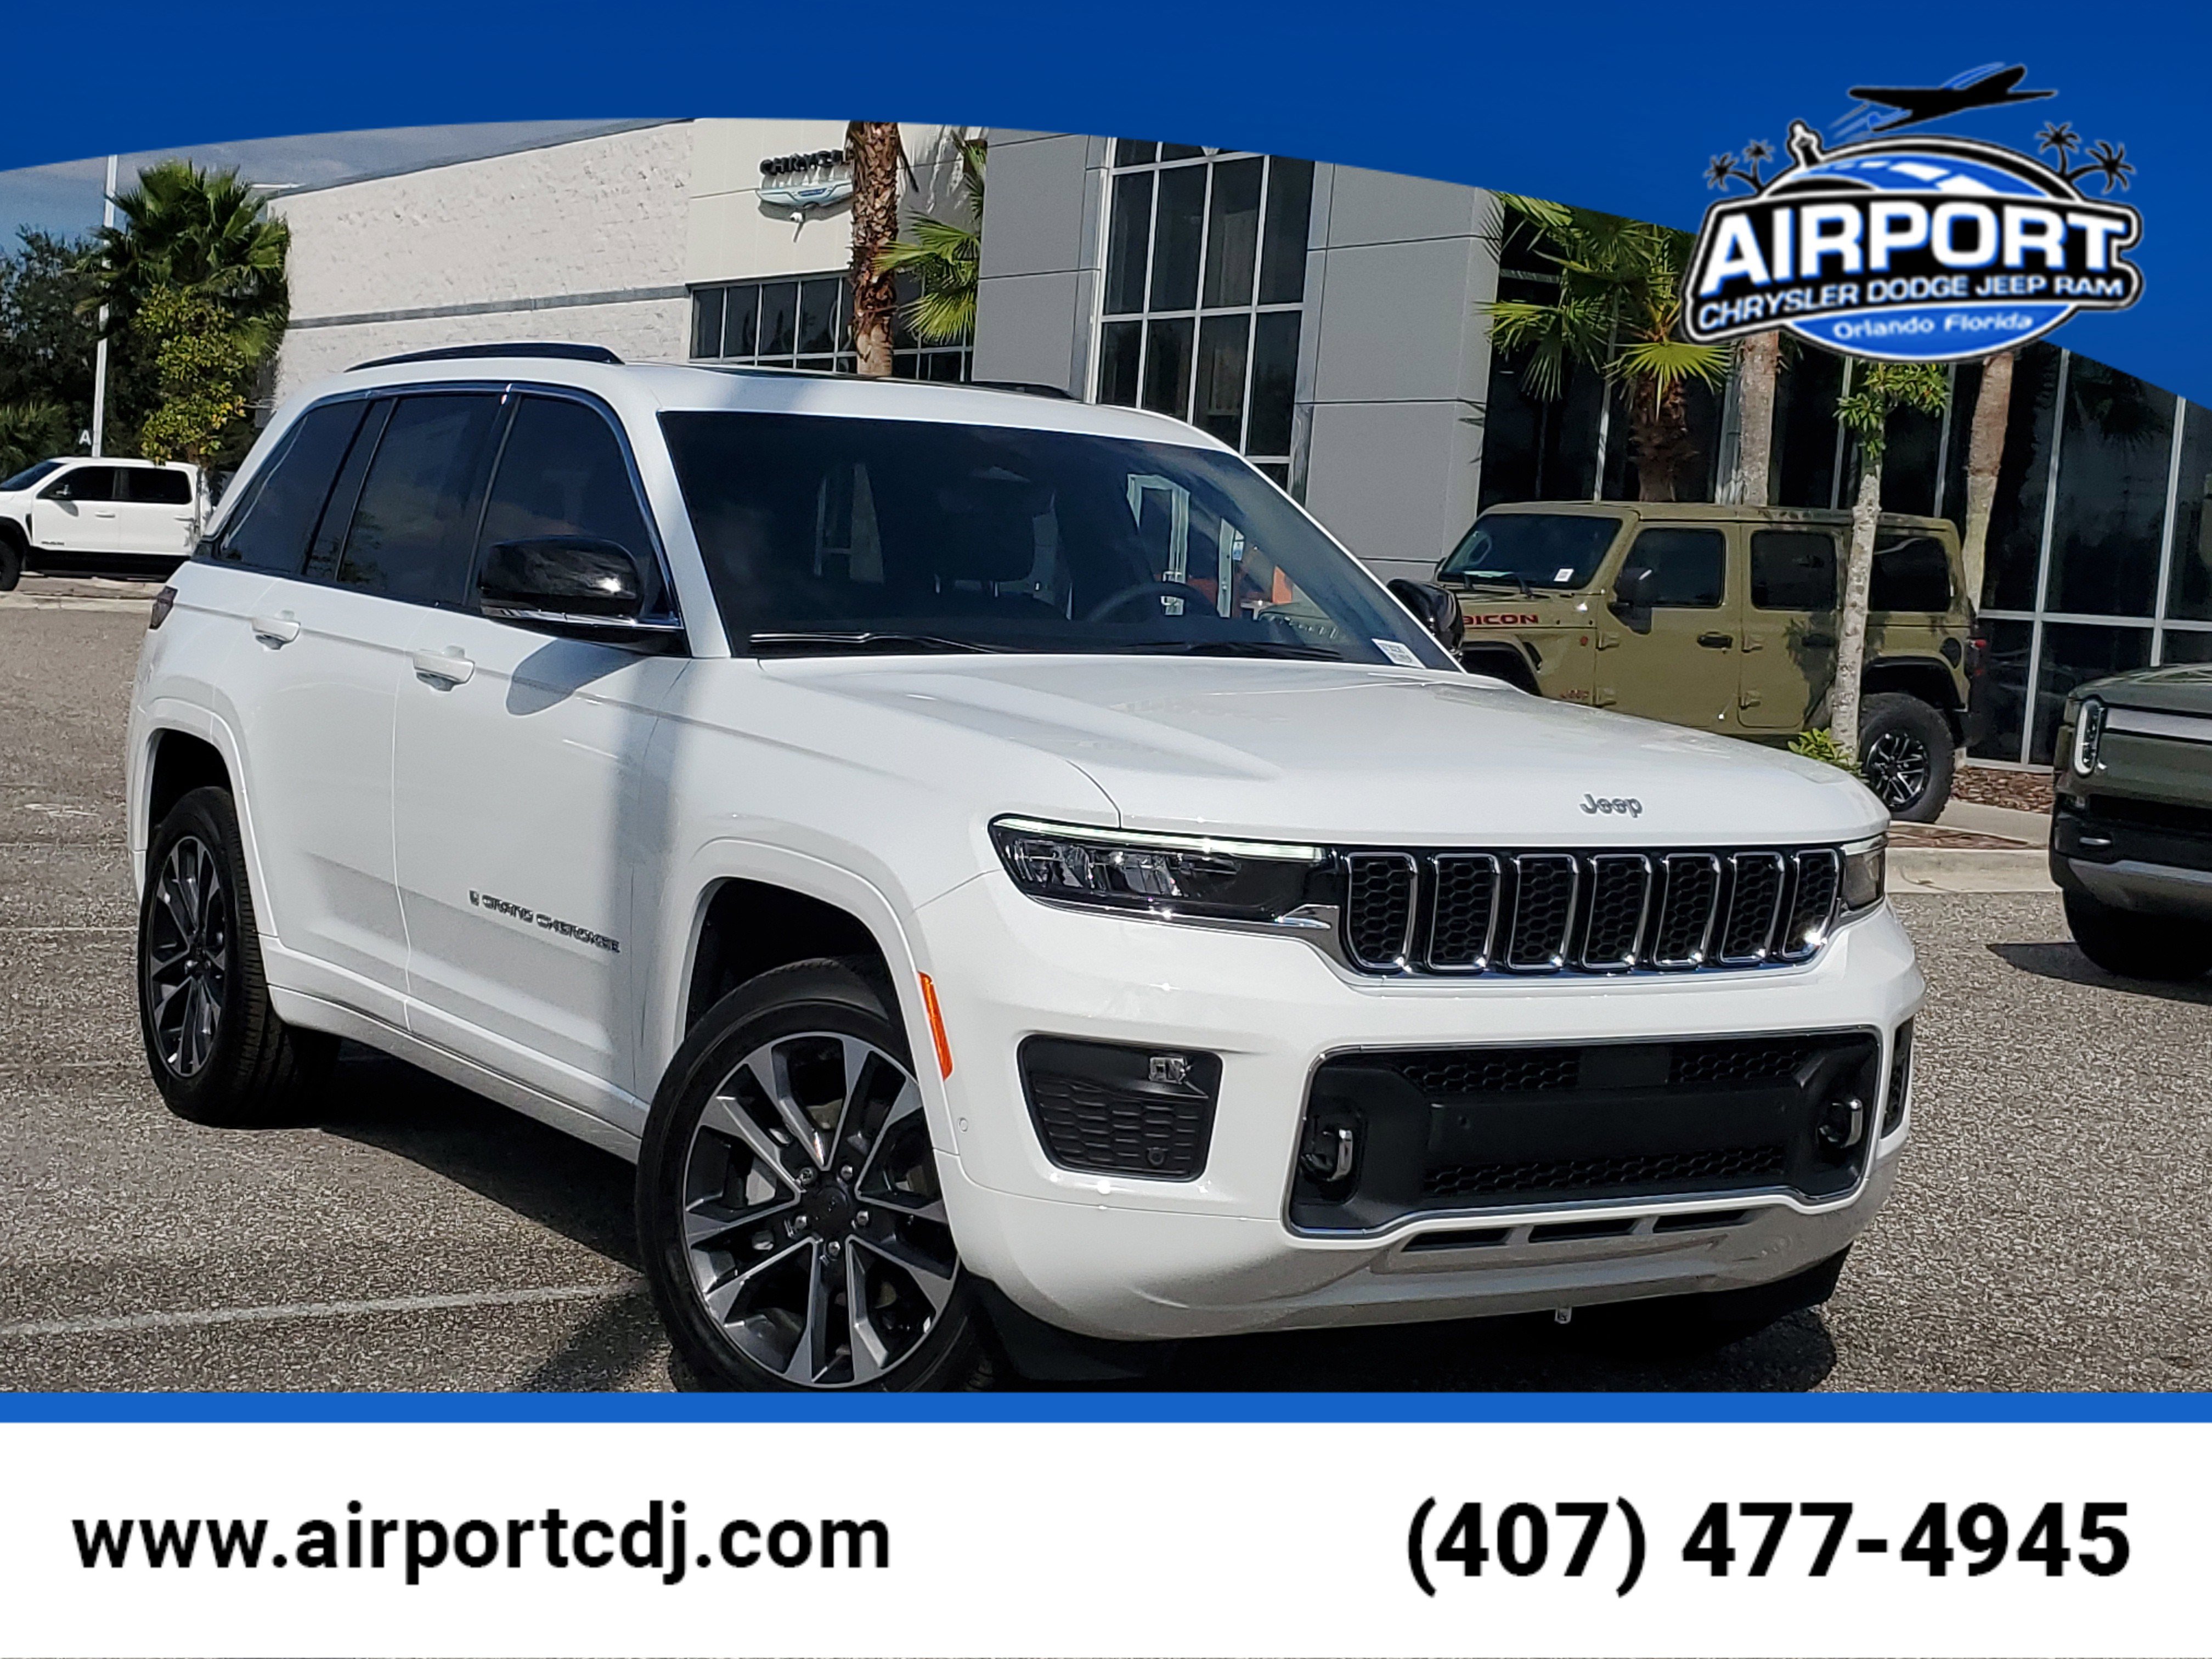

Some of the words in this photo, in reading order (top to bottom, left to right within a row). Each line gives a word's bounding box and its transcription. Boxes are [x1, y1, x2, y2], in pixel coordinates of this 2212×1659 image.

[78, 429, 92, 445] A
[1463, 614, 1538, 625] BICON
[1579, 793, 1643, 818] Jeep
